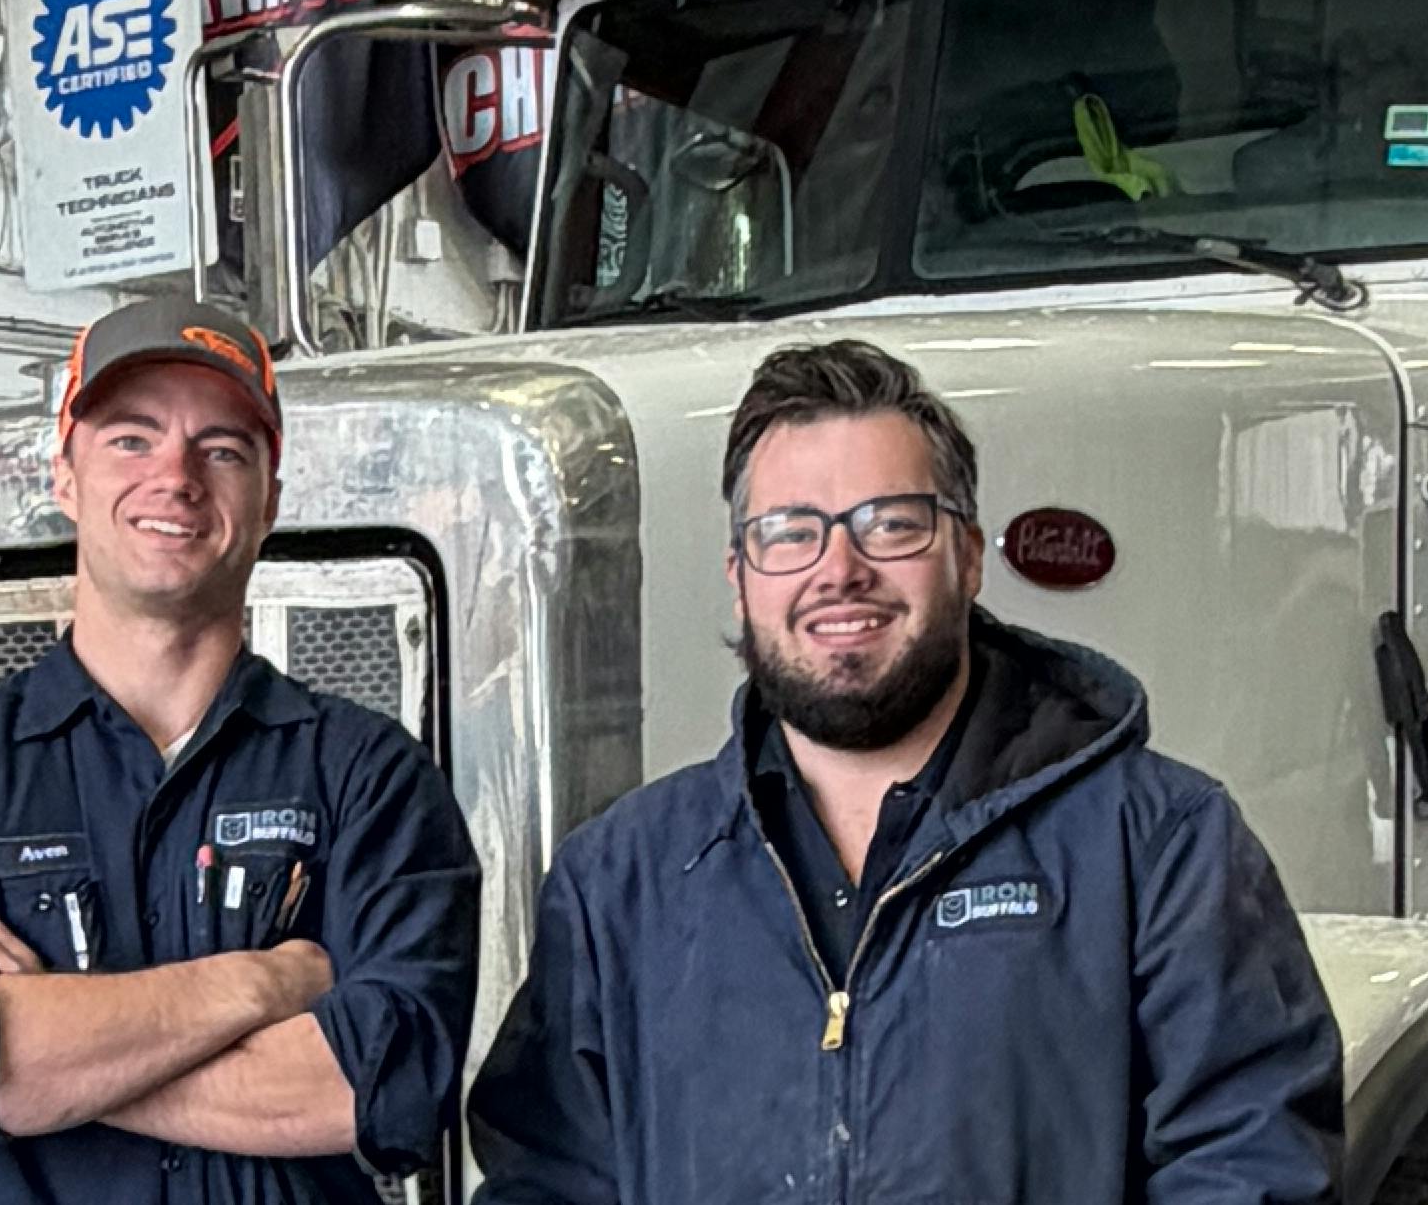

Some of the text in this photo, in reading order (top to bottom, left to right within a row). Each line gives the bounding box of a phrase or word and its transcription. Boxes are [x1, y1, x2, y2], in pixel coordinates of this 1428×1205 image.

[58, 59, 153, 95] CERTIFIED
[82, 166, 143, 190] TRUCK
[252, 808, 316, 830] IRON
[972, 882, 1038, 904] IRON
